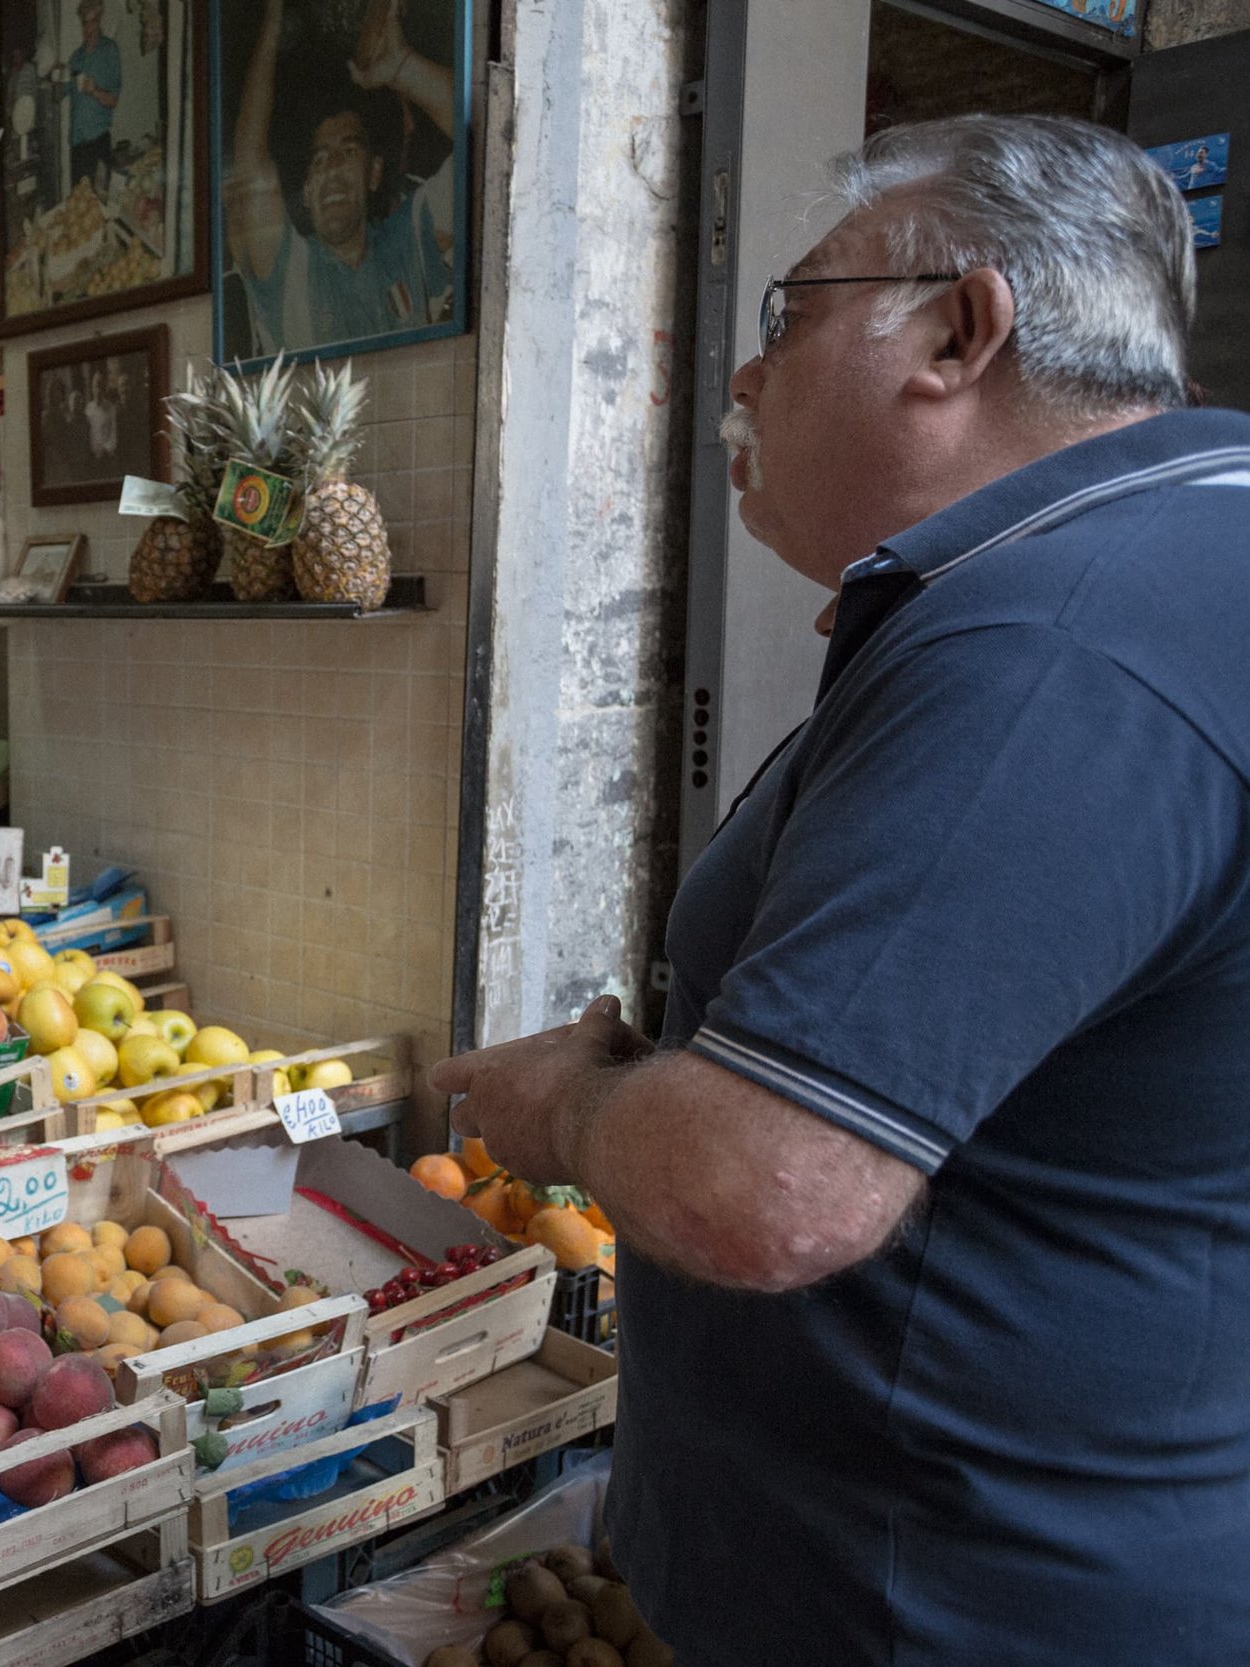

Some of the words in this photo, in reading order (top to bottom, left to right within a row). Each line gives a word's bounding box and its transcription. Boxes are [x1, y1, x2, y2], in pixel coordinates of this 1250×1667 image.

[308, 1116, 336, 1138] KILO
[24, 1207, 63, 1233] KILO
[503, 1422, 551, 1449] Natura
[263, 1485, 418, 1569] Genuino
